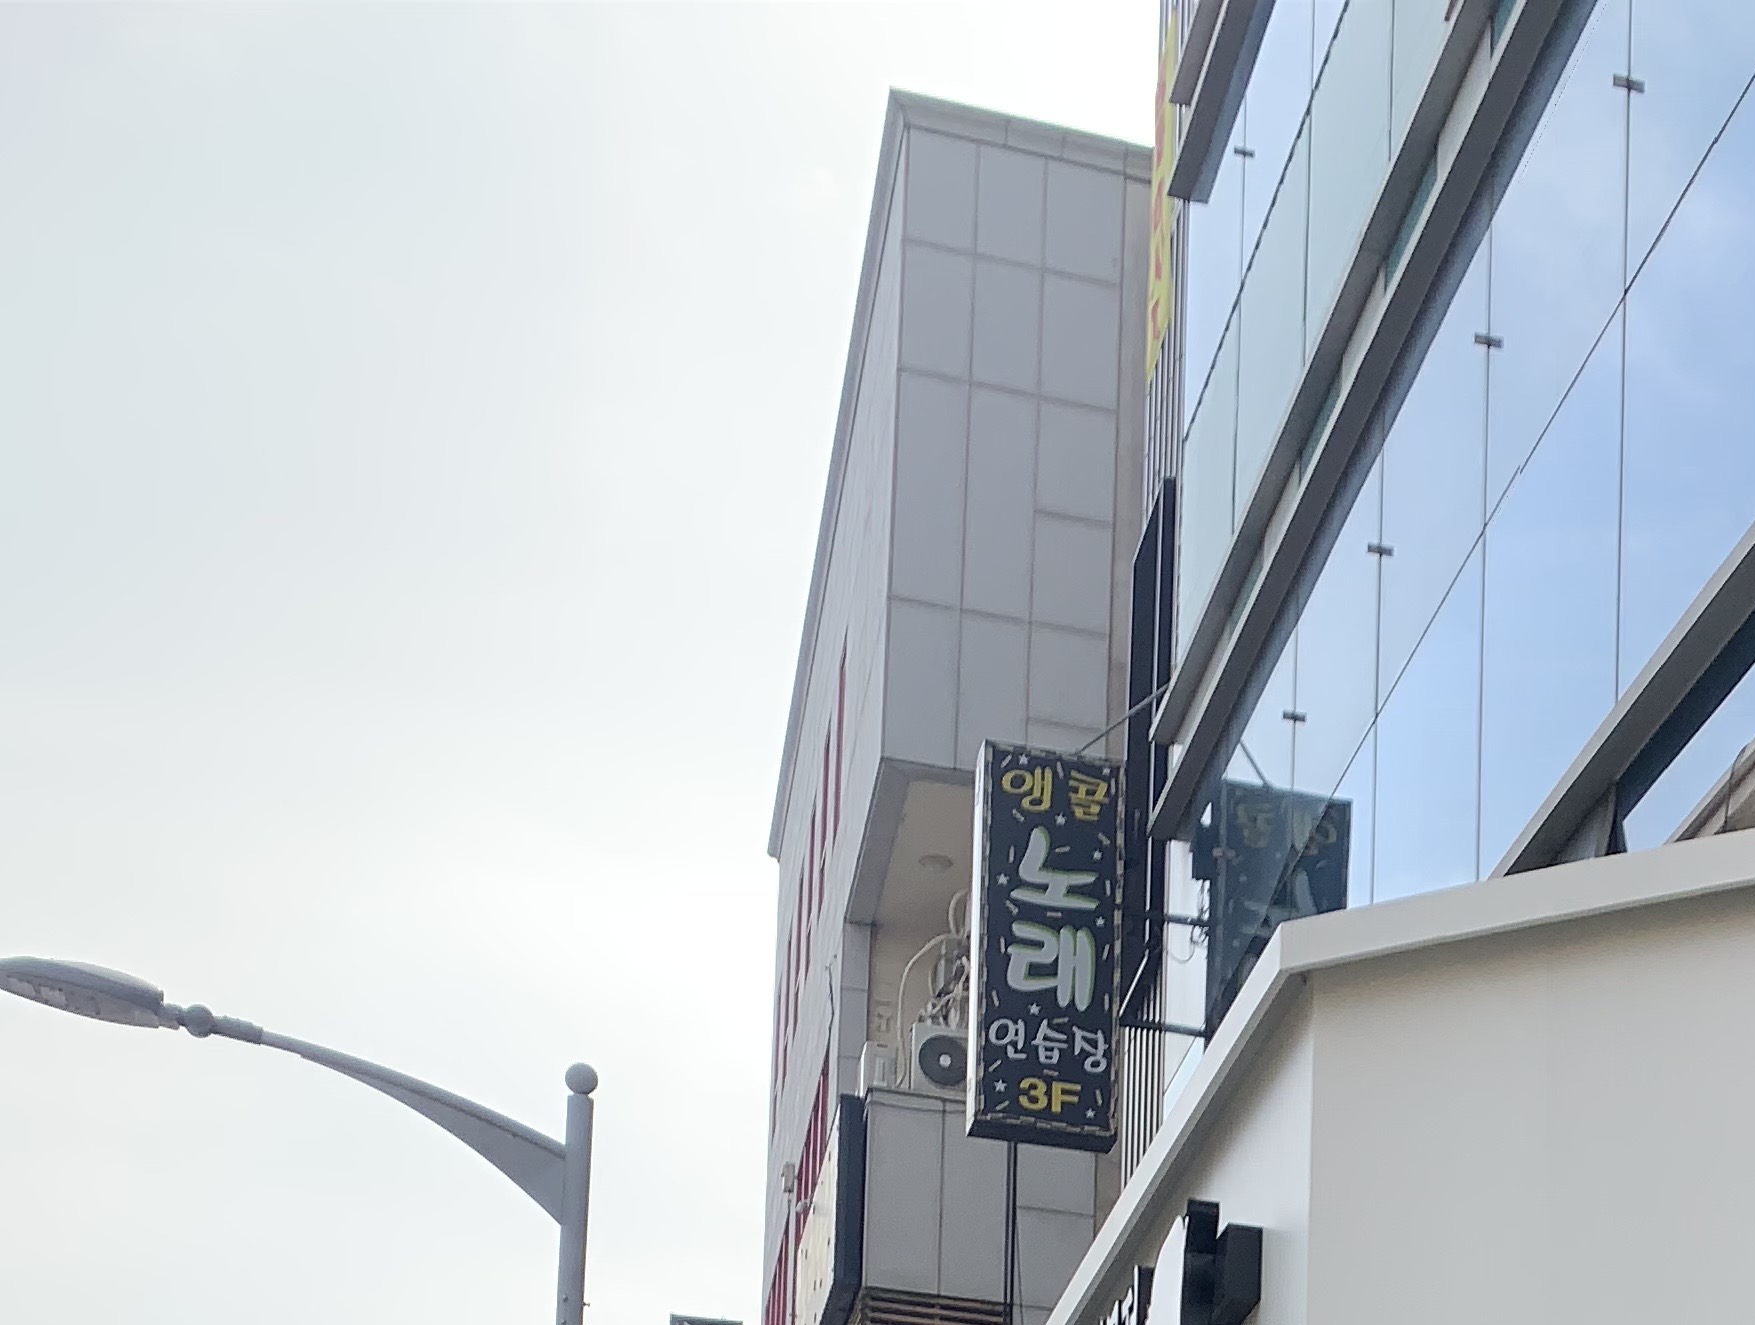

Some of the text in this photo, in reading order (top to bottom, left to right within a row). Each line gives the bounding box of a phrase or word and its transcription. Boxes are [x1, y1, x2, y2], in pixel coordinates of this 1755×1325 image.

[1001, 765, 1109, 823] 앵콜
[1005, 825, 1096, 1012] 노래
[988, 1015, 1109, 1074] 연습장
[1018, 1076, 1082, 1114] 3F
